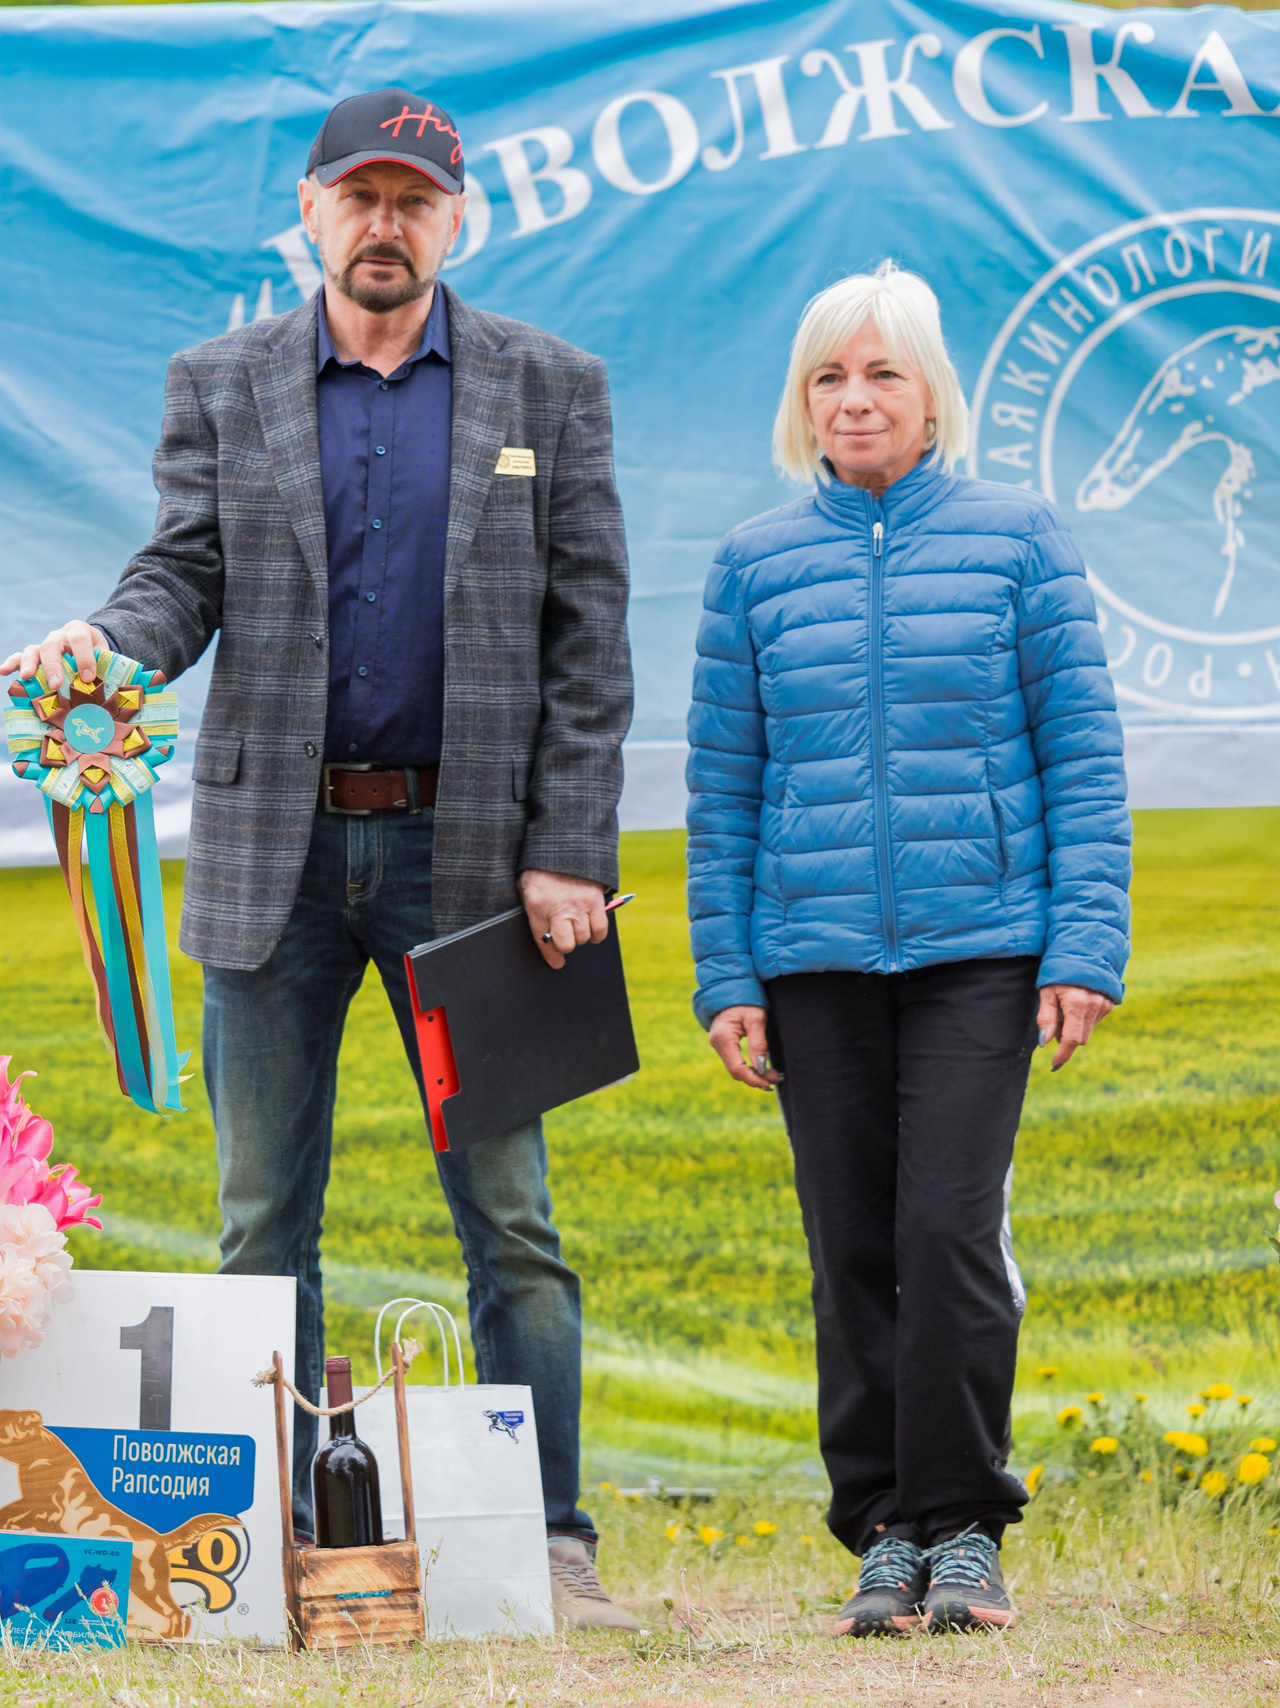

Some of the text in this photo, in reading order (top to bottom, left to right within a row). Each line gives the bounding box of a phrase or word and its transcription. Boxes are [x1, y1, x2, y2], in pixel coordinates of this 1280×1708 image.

[261, 22, 1280, 302] ВОЛЖСКА
[119, 1306, 175, 1431] 1
[111, 1466, 210, 1500] Рапсодия
[113, 1434, 241, 1466] Поволжская
